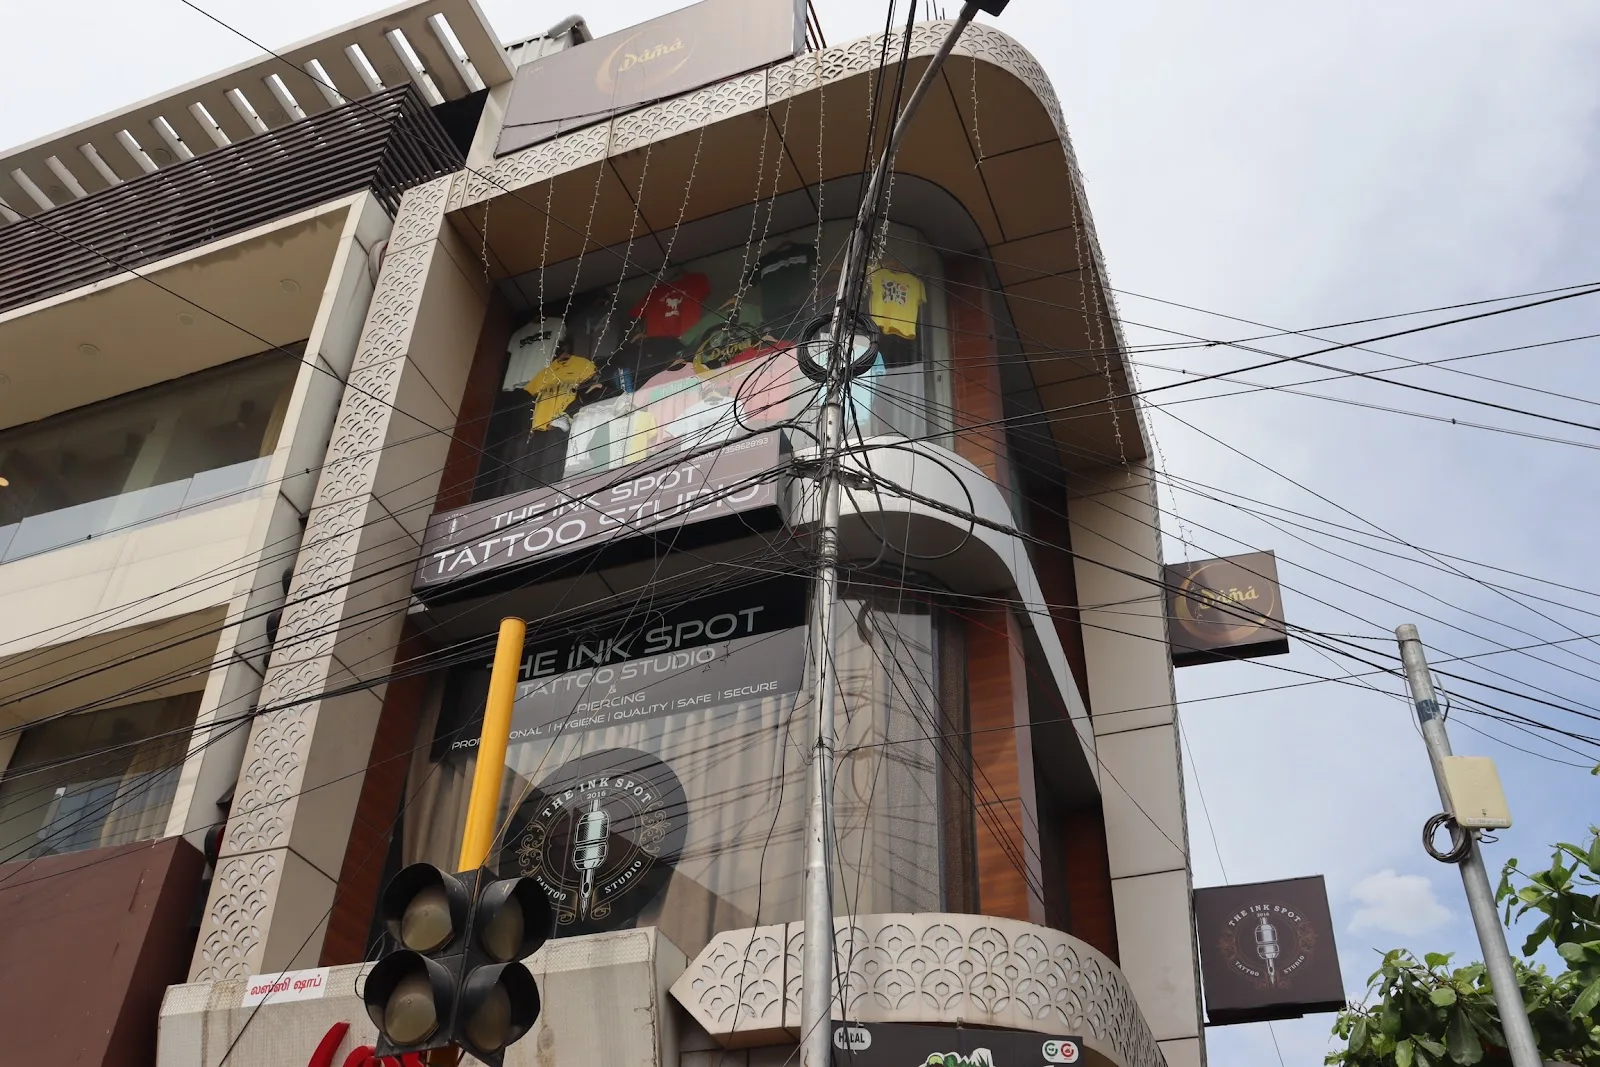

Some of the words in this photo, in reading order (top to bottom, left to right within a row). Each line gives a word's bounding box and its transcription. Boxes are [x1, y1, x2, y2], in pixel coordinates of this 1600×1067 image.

[491, 502, 545, 531] THE
[611, 464, 701, 502] SPOT
[433, 519, 586, 575] TATTOO
[598, 479, 760, 537] STUDIO
[486, 649, 558, 679] HE
[644, 606, 765, 653] SPOT
[520, 667, 615, 700] TATTOO
[621, 647, 716, 681] STUDIO
[609, 685, 618, 694] &
[554, 713, 605, 731] HYGIENE
[613, 702, 668, 720] QUALITY
[677, 693, 712, 709] SAFE
[724, 680, 778, 700] SECURE
[576, 692, 647, 714] PIERCING
[542, 790, 574, 818] THE
[579, 777, 610, 793] INK
[614, 778, 652, 804] SPOT
[586, 790, 607, 799] 2016
[536, 875, 567, 901] TATTOO
[604, 860, 642, 894] STUDIO
[1229, 911, 1248, 927] THE
[1250, 904, 1270, 913] INK
[1274, 905, 1301, 923] SPOT
[294, 974, 323, 993] ஷாப்
[1235, 961, 1260, 977] TATTOO
[1283, 955, 1305, 974] STUDIO
